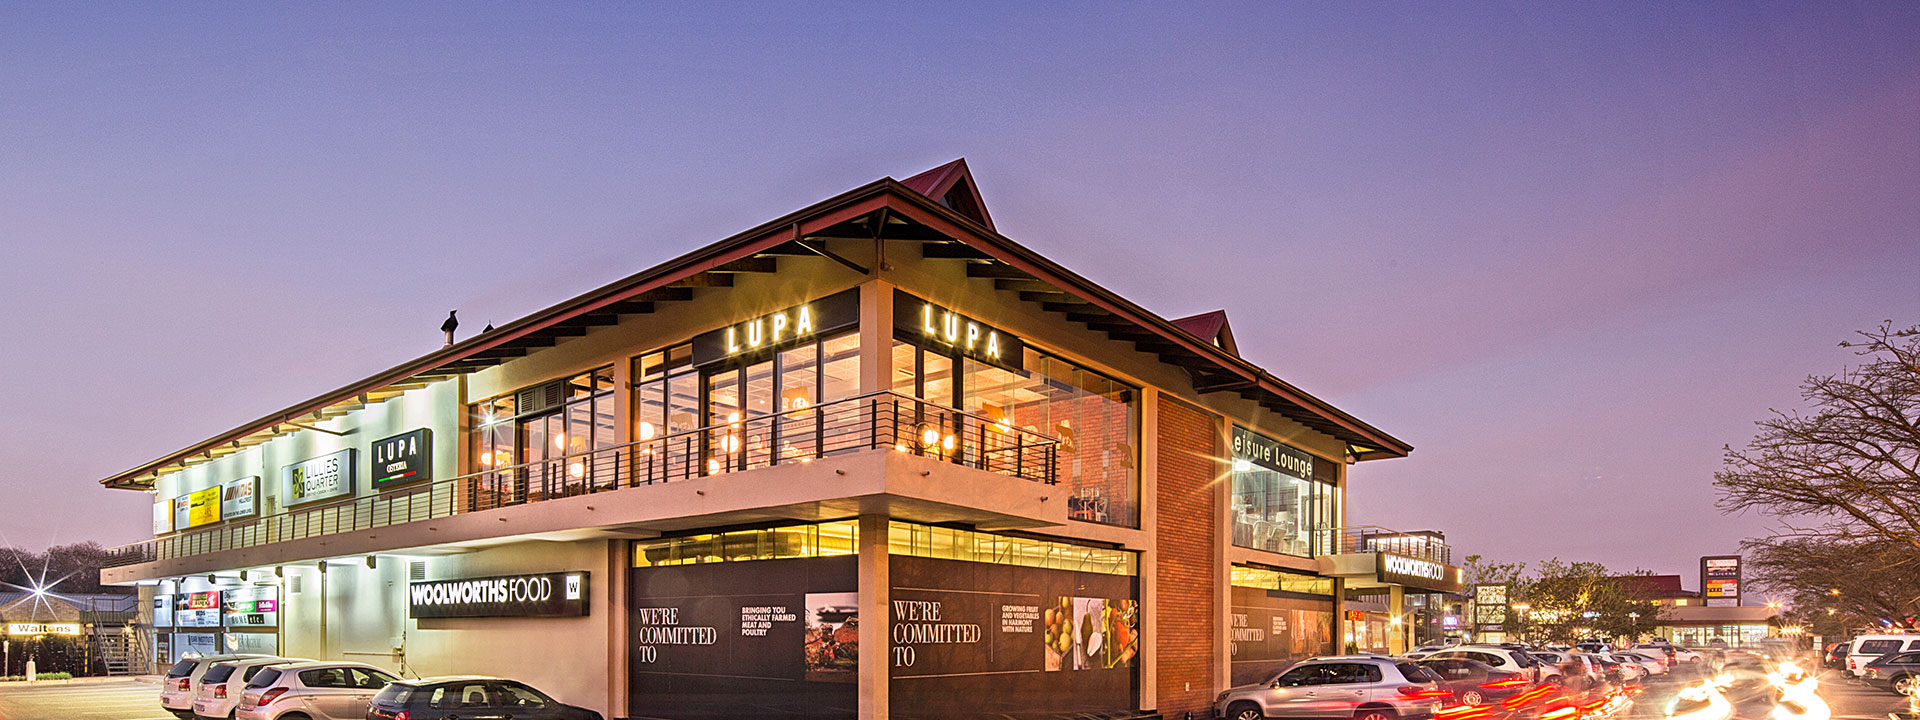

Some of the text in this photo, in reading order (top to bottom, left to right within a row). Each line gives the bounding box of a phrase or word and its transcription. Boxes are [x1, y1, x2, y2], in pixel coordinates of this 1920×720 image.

[728, 305, 812, 353] LUPA
[924, 304, 1000, 358] LUPA
[377, 436, 417, 463] LUPA
[1232, 434, 1312, 478] eisure Lounge
[306, 457, 339, 478] LILLIES
[306, 474, 339, 491] QUARTER
[568, 582, 579, 593] W
[639, 607, 679, 625] WE'RE
[771, 614, 796, 622] FARMED
[893, 600, 942, 621] WE'RE
[18, 624, 71, 633] Waltons
[758, 621, 772, 629] AND
[893, 623, 981, 644] COMMITTED
[1015, 625, 1033, 633] NATURE
[639, 627, 717, 645] COMMITTED
[1231, 628, 1265, 641] OMMITTED
[639, 646, 657, 663] TO
[893, 646, 916, 667] TO
